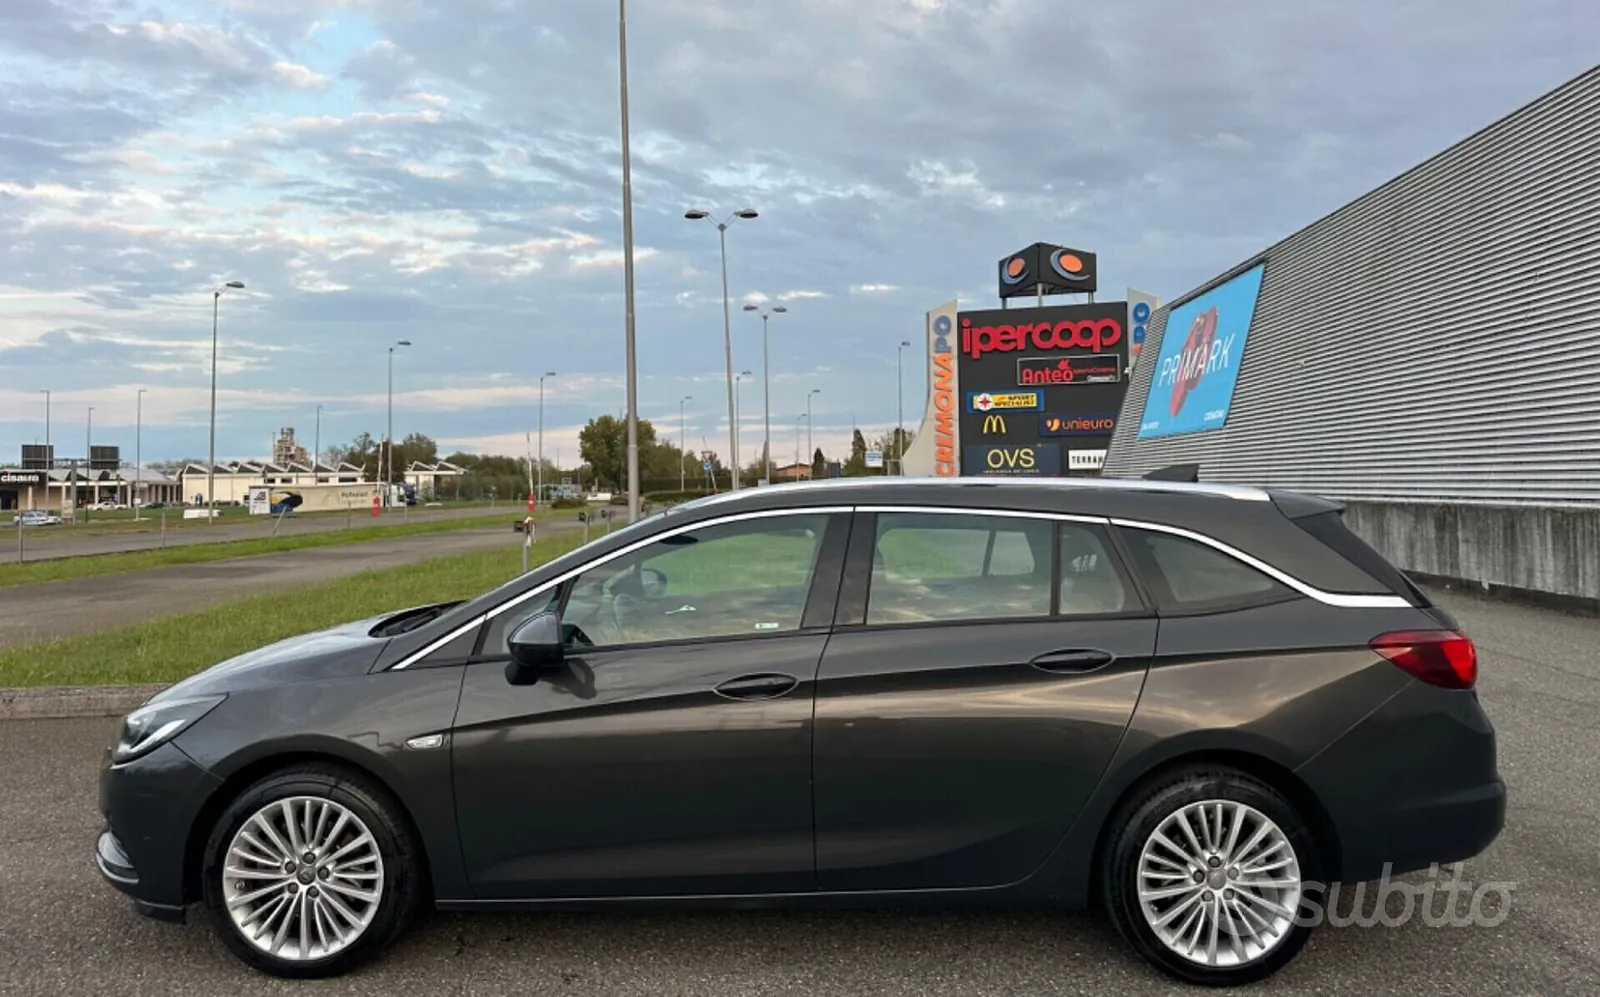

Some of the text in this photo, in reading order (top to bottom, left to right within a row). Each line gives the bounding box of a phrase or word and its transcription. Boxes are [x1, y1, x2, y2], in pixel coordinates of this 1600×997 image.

[962, 318, 1121, 359] ipercoop
[1158, 333, 1235, 388] PRIMARK
[1022, 367, 1074, 383] Anteo
[1062, 418, 1114, 430] unieuro
[987, 448, 1035, 468] OVS
